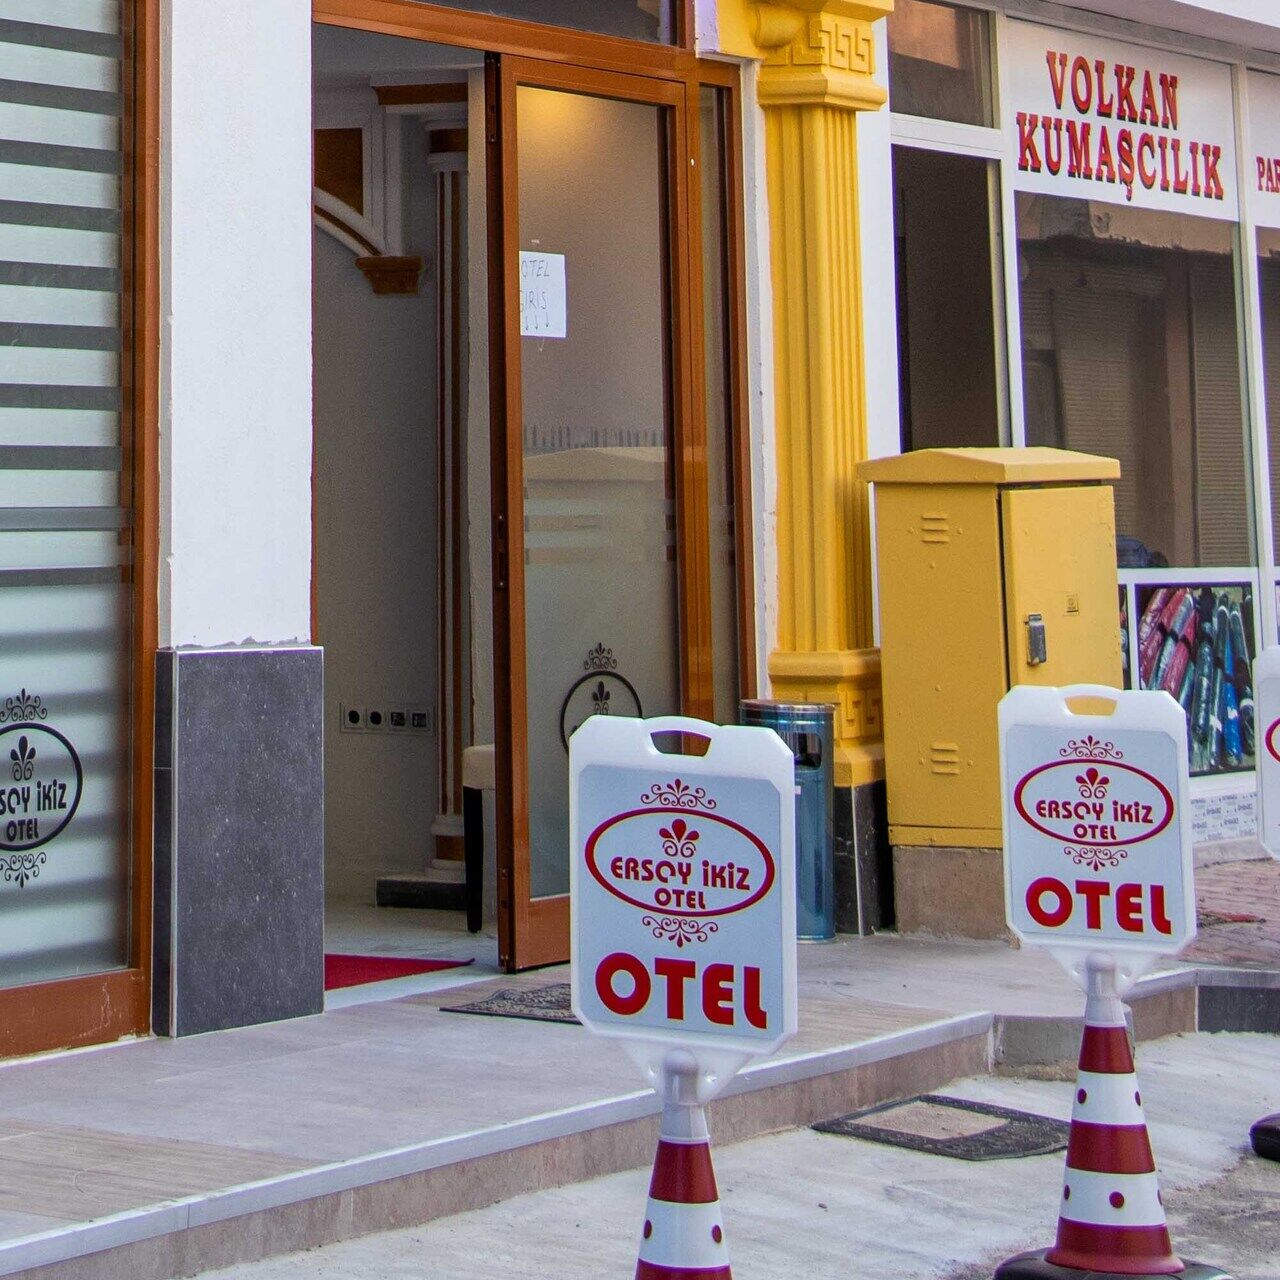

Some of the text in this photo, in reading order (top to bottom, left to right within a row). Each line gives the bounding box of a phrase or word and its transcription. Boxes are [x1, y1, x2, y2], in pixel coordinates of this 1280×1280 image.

[1046, 50, 1179, 131] VOLKAN
[1016, 111, 1224, 202] KUMAŞCILIK
[521, 259, 550, 279] OTEL
[36, 779, 67, 811] İKİZ
[1035, 798, 1154, 824] ERSOY İKİZ
[5, 818, 39, 842] OTEL
[1073, 823, 1117, 841] OTEL
[610, 855, 751, 892] ERSOY İKİZ
[654, 887, 706, 910] OTEL
[1024, 876, 1173, 935] OTEL
[594, 951, 769, 1030] OTEL
